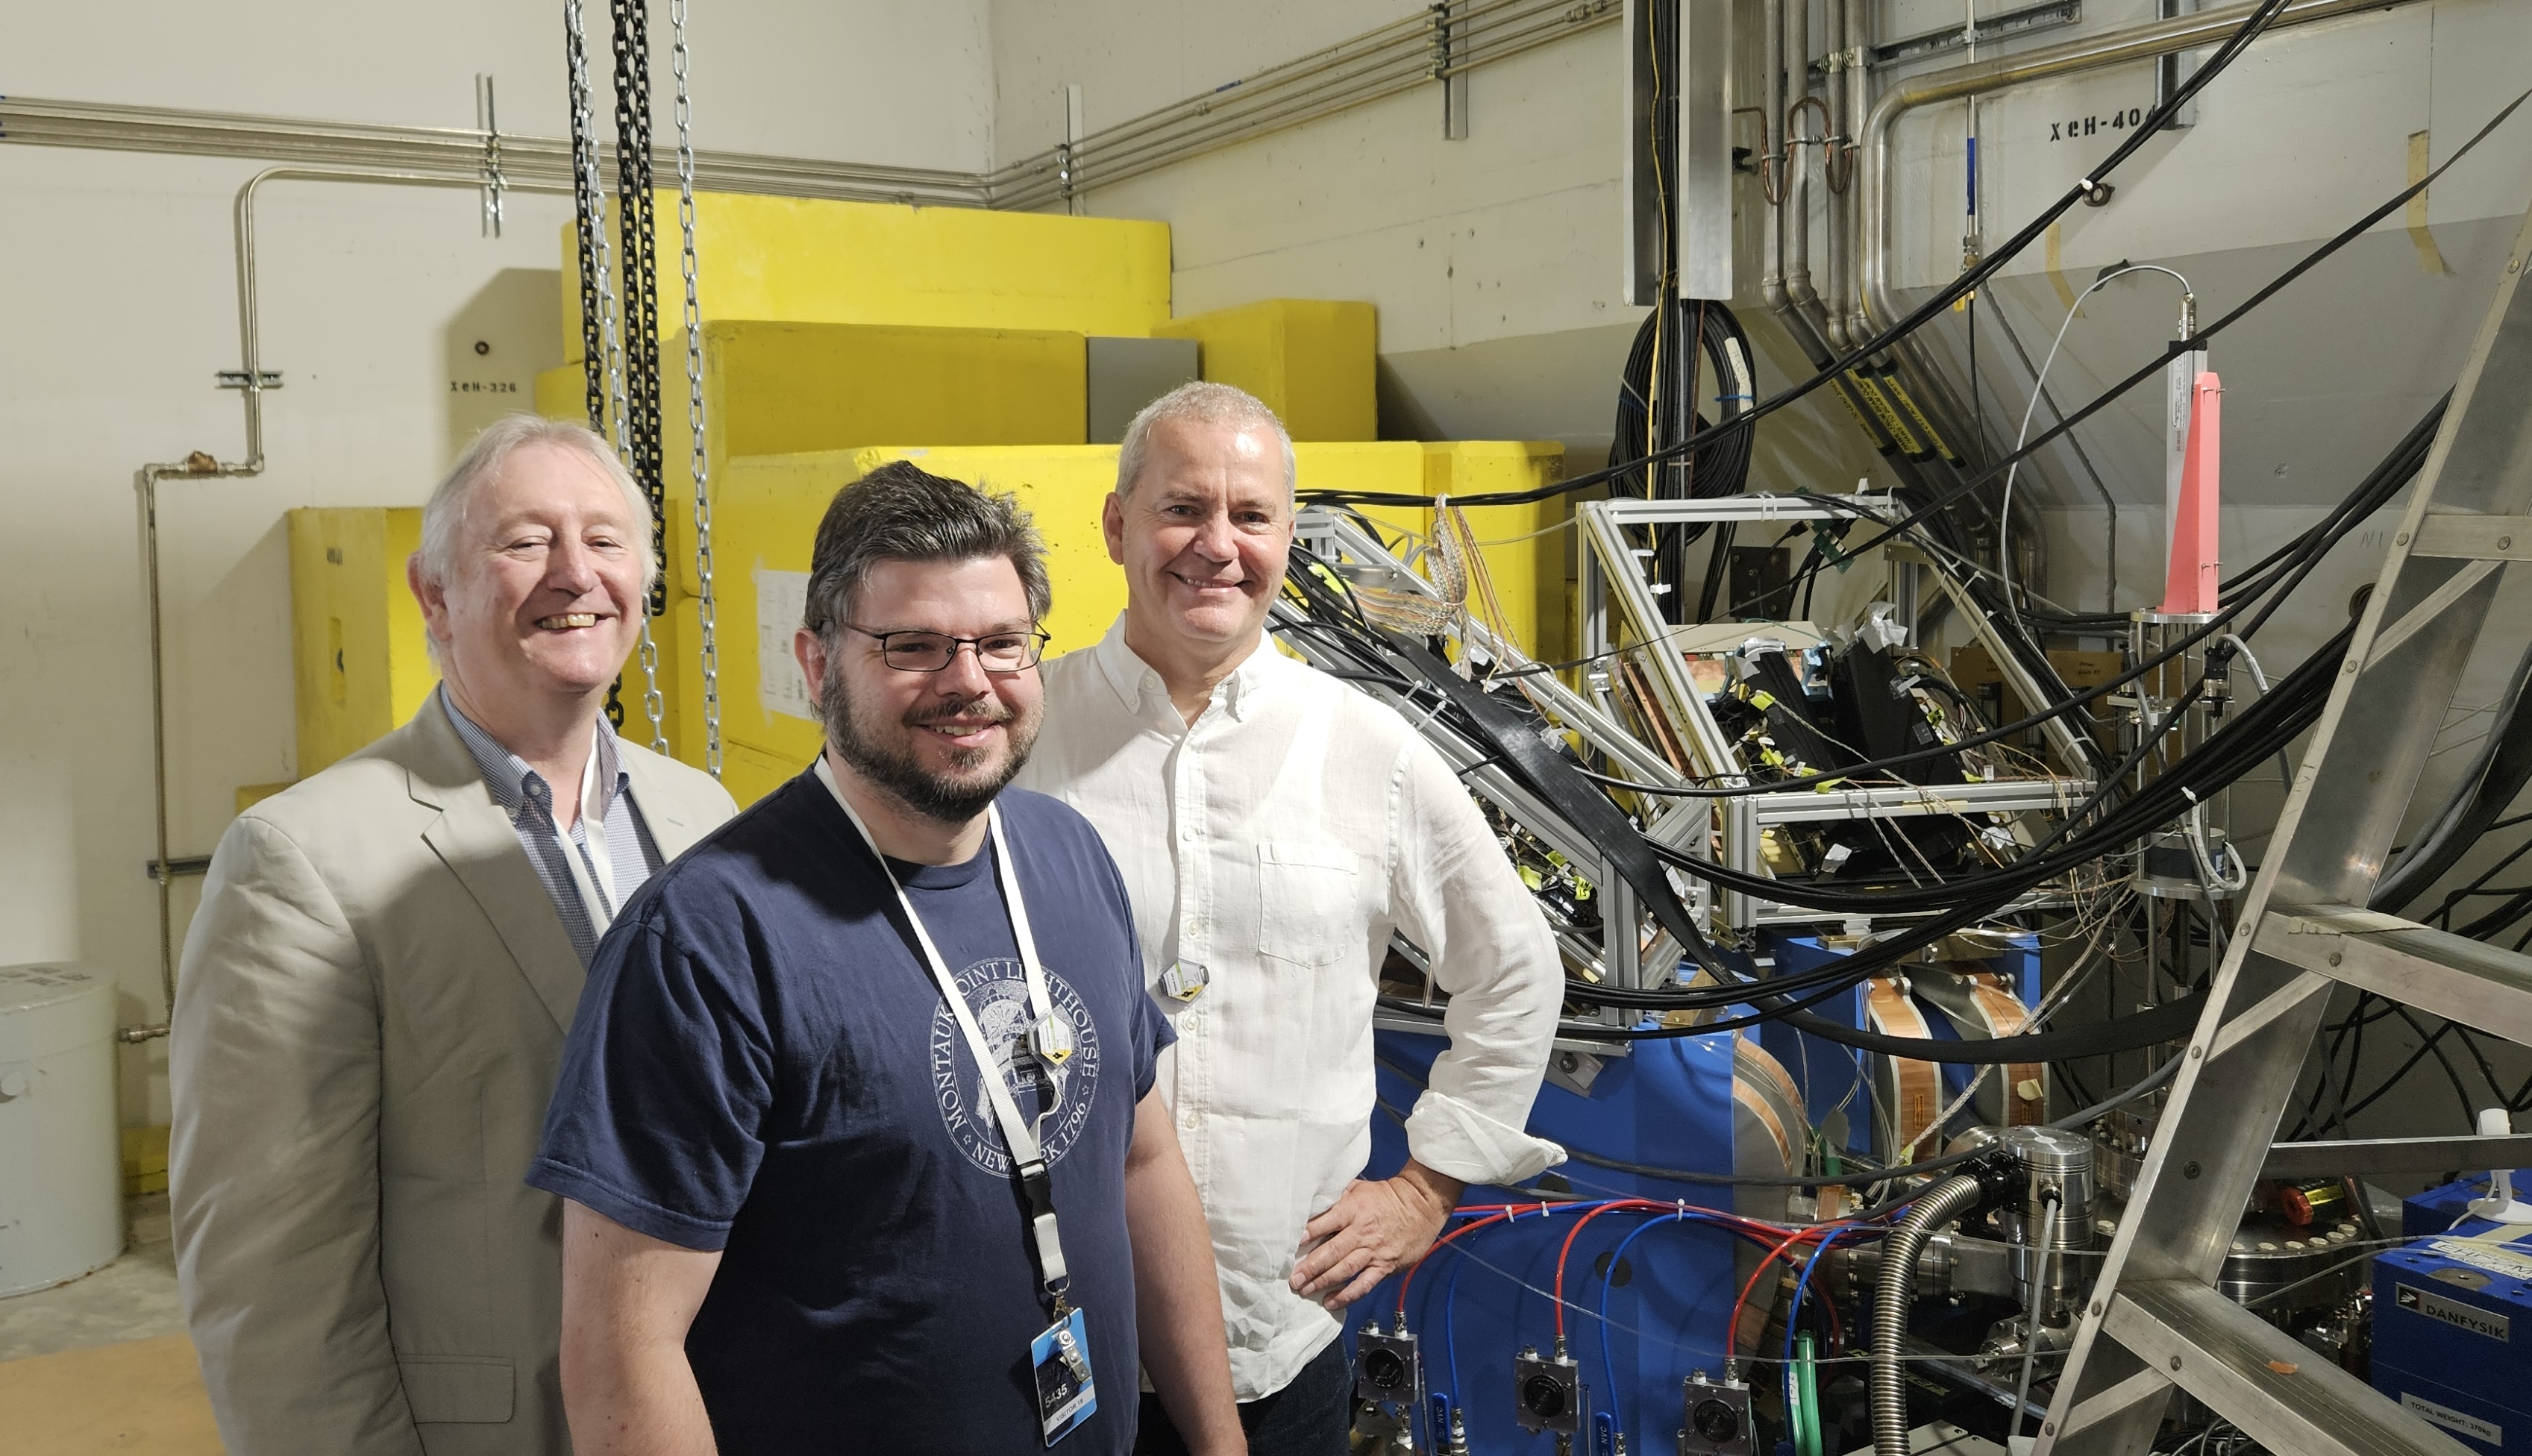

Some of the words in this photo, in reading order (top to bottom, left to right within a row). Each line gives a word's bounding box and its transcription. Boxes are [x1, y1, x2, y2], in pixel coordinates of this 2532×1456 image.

[935, 1004, 968, 1132] MONTAUK
[955, 963, 1000, 997] OINT
[1007, 963, 1097, 1078] LIHTHOUSE
[972, 1142, 1011, 1173] NEW
[1059, 1102, 1086, 1146] 1796
[2426, 1304, 2505, 1339] DANFYSIK
[1045, 1383, 1068, 1408] 5435
[1056, 1403, 1077, 1422] VISITOR
[2410, 1401, 2434, 1416] TOTAL
[2436, 1410, 2468, 1428] WEIGHT:
